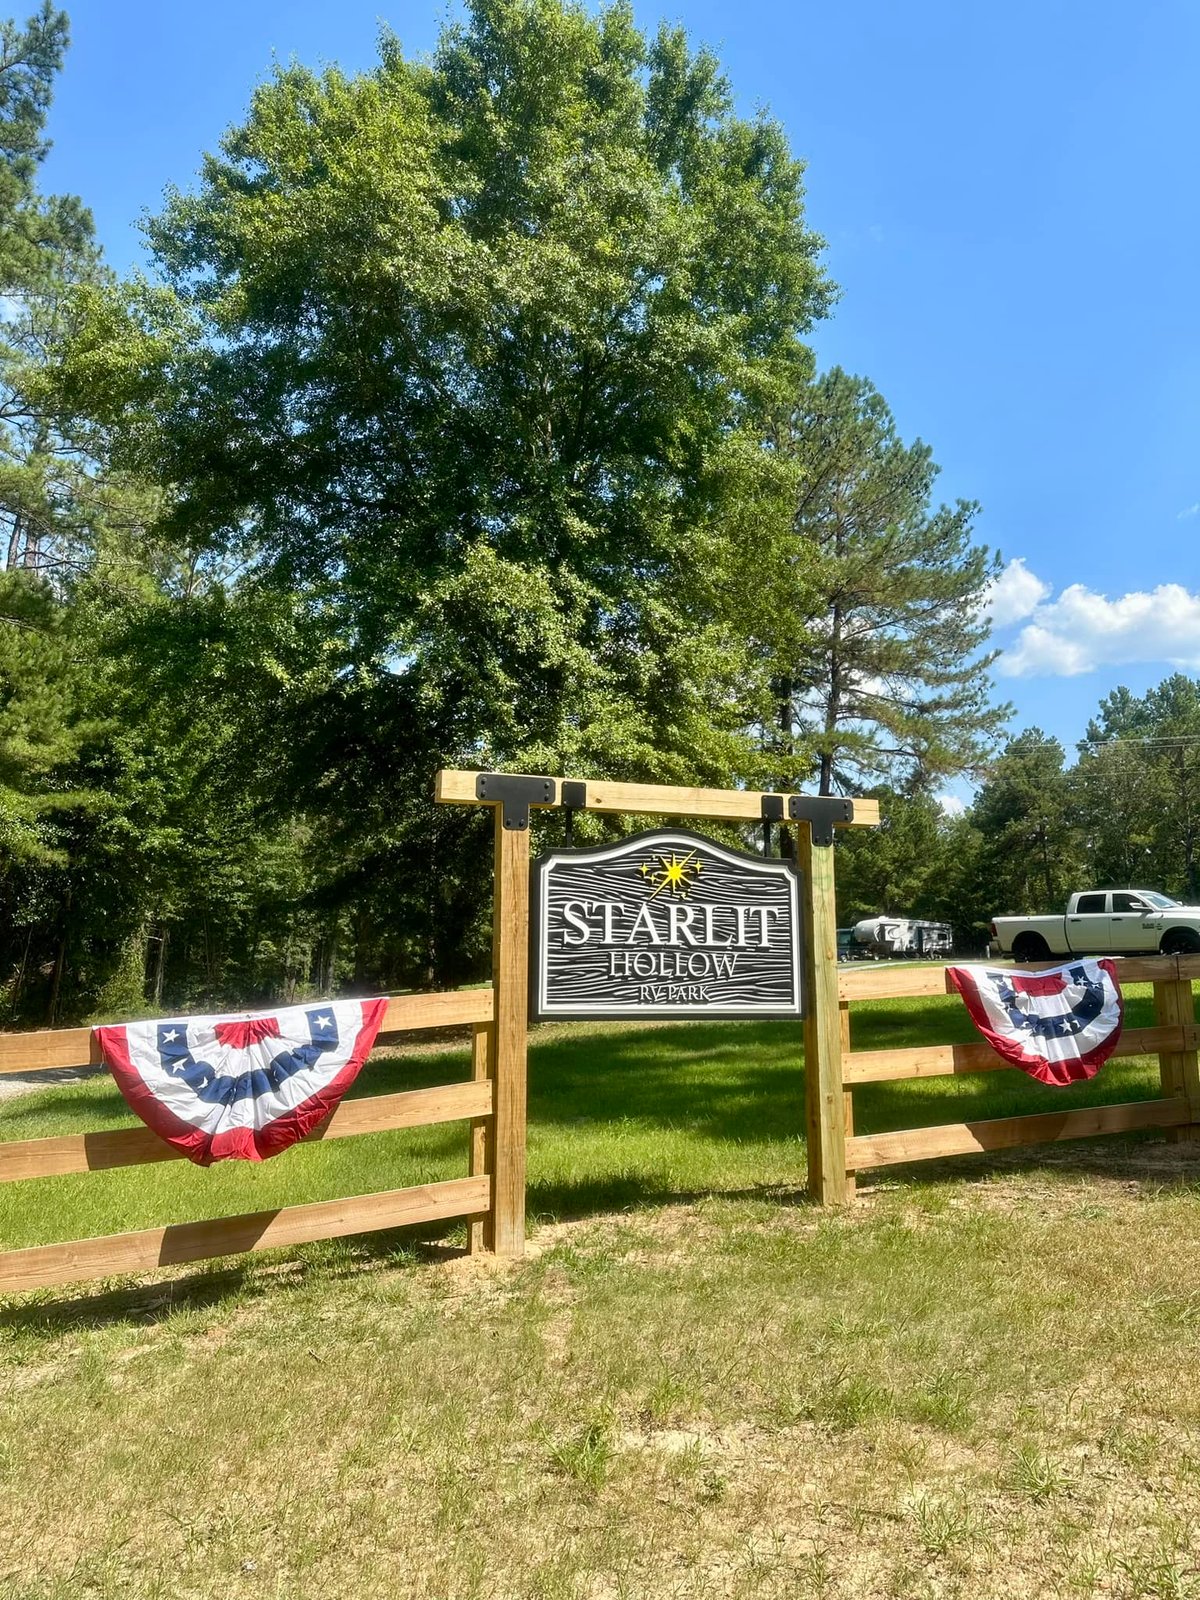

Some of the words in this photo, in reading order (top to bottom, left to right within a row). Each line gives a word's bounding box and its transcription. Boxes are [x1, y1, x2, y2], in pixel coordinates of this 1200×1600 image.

[563, 901, 778, 947] STARLIT
[609, 952, 739, 977] HOLLOW
[641, 986, 663, 1001] RV
[668, 986, 709, 1001] PARK
